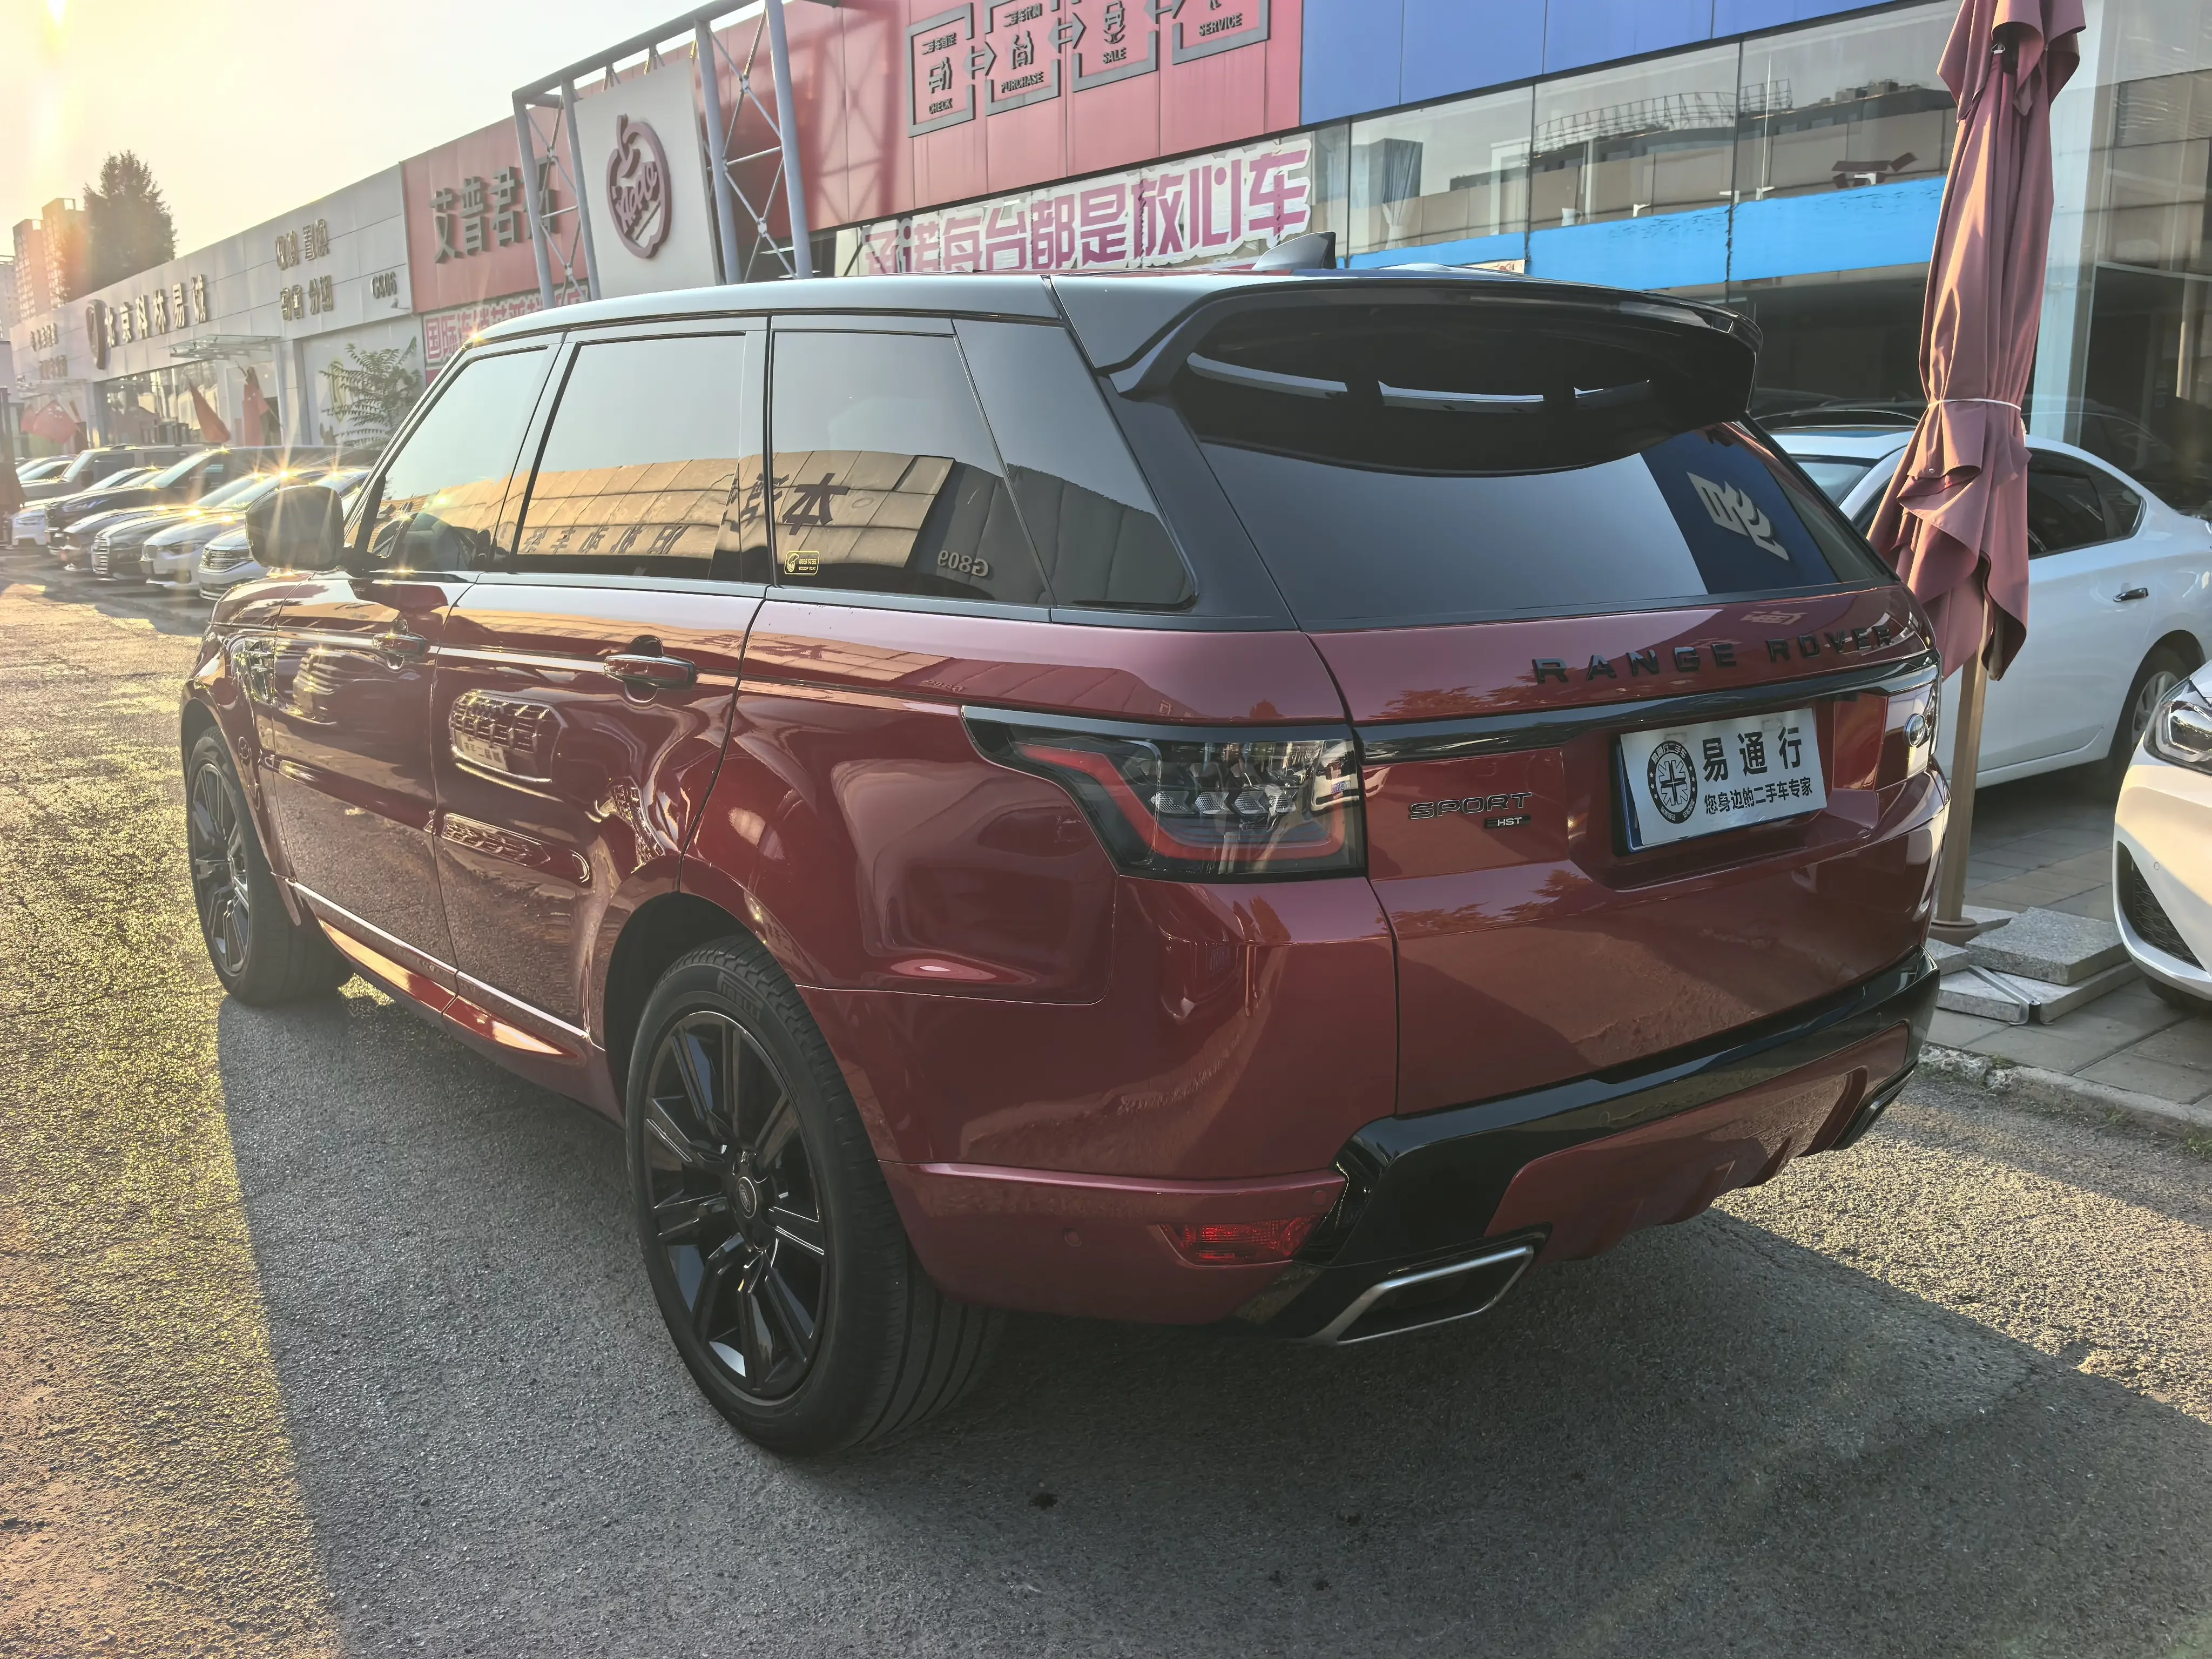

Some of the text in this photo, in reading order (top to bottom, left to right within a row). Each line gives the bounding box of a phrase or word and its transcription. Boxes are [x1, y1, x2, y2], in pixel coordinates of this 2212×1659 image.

[1198, 13, 1243, 36] SERVICE
[1103, 47, 1127, 64] SALE
[1001, 71, 1044, 93] PURCHASE
[929, 98, 953, 114] CHECK
[1532, 625, 1891, 684] RANGE ROVER
[1702, 726, 1802, 783] 易通行
[1409, 792, 1533, 820] SPORT
[1704, 776, 1813, 815] 您身边的二手车专家
[1497, 817, 1522, 827] HST
